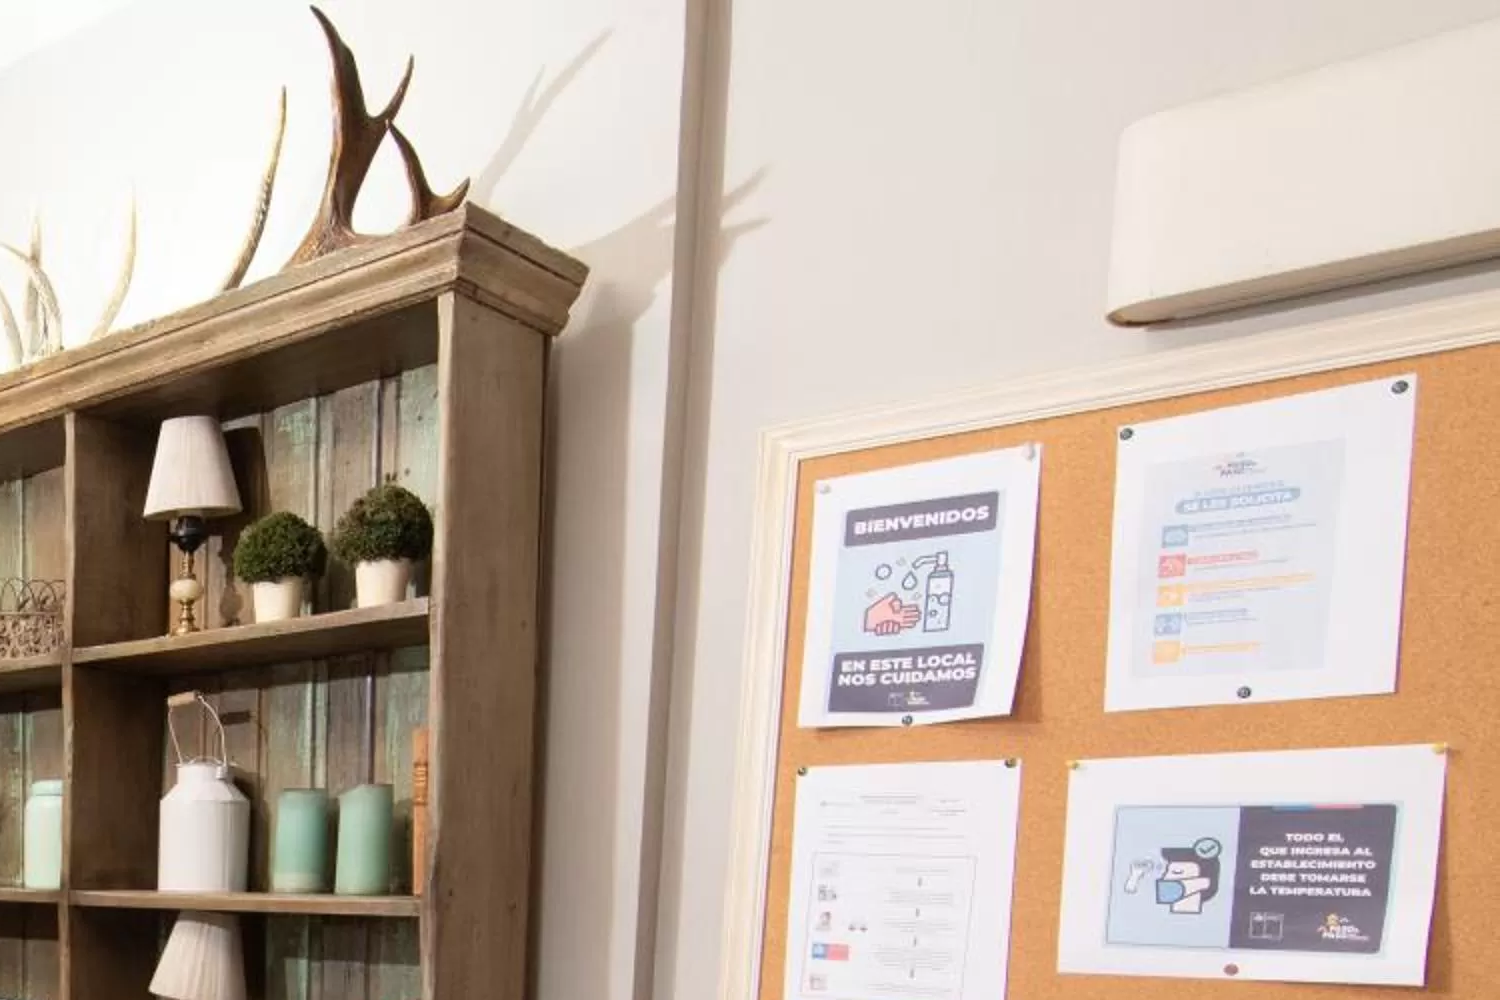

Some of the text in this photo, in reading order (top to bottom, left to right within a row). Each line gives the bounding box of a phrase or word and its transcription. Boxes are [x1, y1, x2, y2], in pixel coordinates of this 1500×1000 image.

[853, 505, 991, 535] BIENVENIDOS
[841, 652, 977, 673] EN ESTE LOCAL
[837, 667, 977, 686] NOS CUIDAMOS
[1285, 833, 1345, 842] TODO EL
[1259, 847, 1373, 857] QUE INGRESA AL
[1250, 860, 1377, 869] ESTABLECIMIENTO
[1261, 873, 1367, 883] DEBE TOMARSE
[1249, 886, 1372, 896] LA TEMPERATURA
